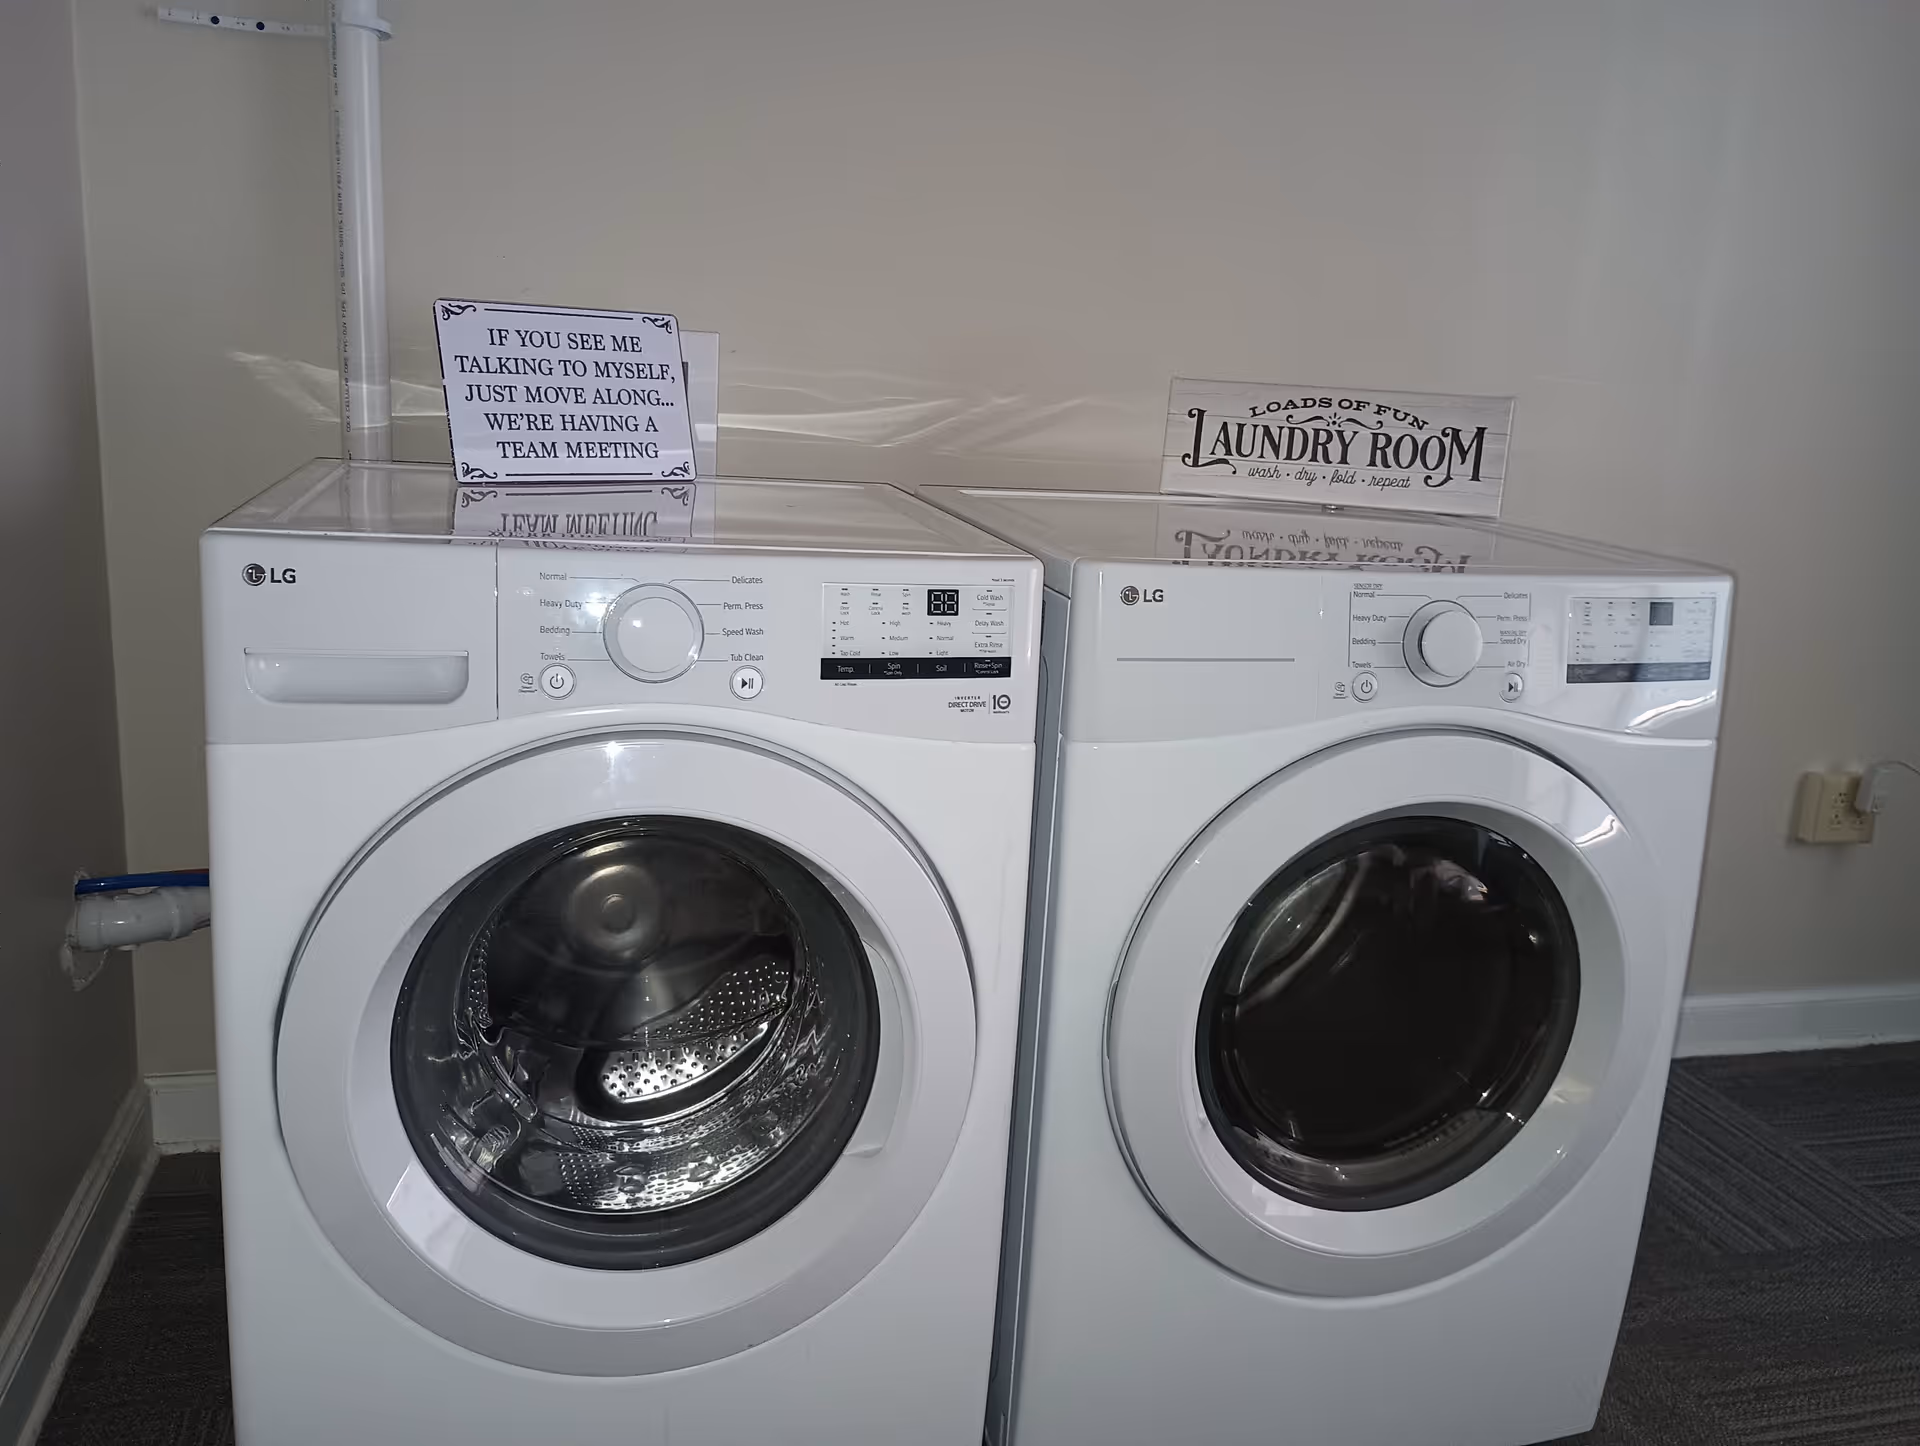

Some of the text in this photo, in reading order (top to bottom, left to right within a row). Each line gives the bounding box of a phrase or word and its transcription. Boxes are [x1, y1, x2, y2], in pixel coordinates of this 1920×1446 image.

[487, 328, 642, 353] IF YOU SEE ME
[454, 355, 676, 384] TALKING TO MYSELF,
[465, 384, 674, 407] JUST MOVE ALONG...
[1249, 397, 1429, 431] LOADS OF FUN
[485, 413, 659, 432] WE’RE HAVING A
[497, 441, 659, 459] TEAM MEETING
[1181, 407, 1488, 488] LAUNDRY ROOM
[1248, 467, 1411, 491] wash dry fold repeat
[270, 568, 297, 584] LG
[539, 572, 567, 581] Normal
[731, 576, 764, 585] Delicates
[976, 594, 989, 602] Cold
[1143, 588, 1164, 603] LG
[1353, 591, 1375, 599] Normal
[1503, 592, 1529, 600] Delicates
[539, 599, 583, 609] Heavy Duty
[723, 602, 764, 611] Perm. Press
[1352, 615, 1387, 623] Heavy Duty
[974, 620, 989, 628] Delay
[539, 626, 570, 636] Bedding
[722, 627, 764, 638] Speed Wash
[974, 641, 990, 649] Extra
[1352, 638, 1377, 647] Bedding
[1499, 638, 1527, 646] Speed Dry
[540, 652, 565, 661] Towels
[730, 653, 764, 662] Tub Clean
[837, 665, 855, 674] Temp.
[887, 662, 901, 671] Spin
[935, 664, 948, 673] Soil
[1352, 661, 1372, 669] Towels
[1516, 661, 1526, 669] Dry
[947, 701, 987, 709] DIRECT DRIVE
